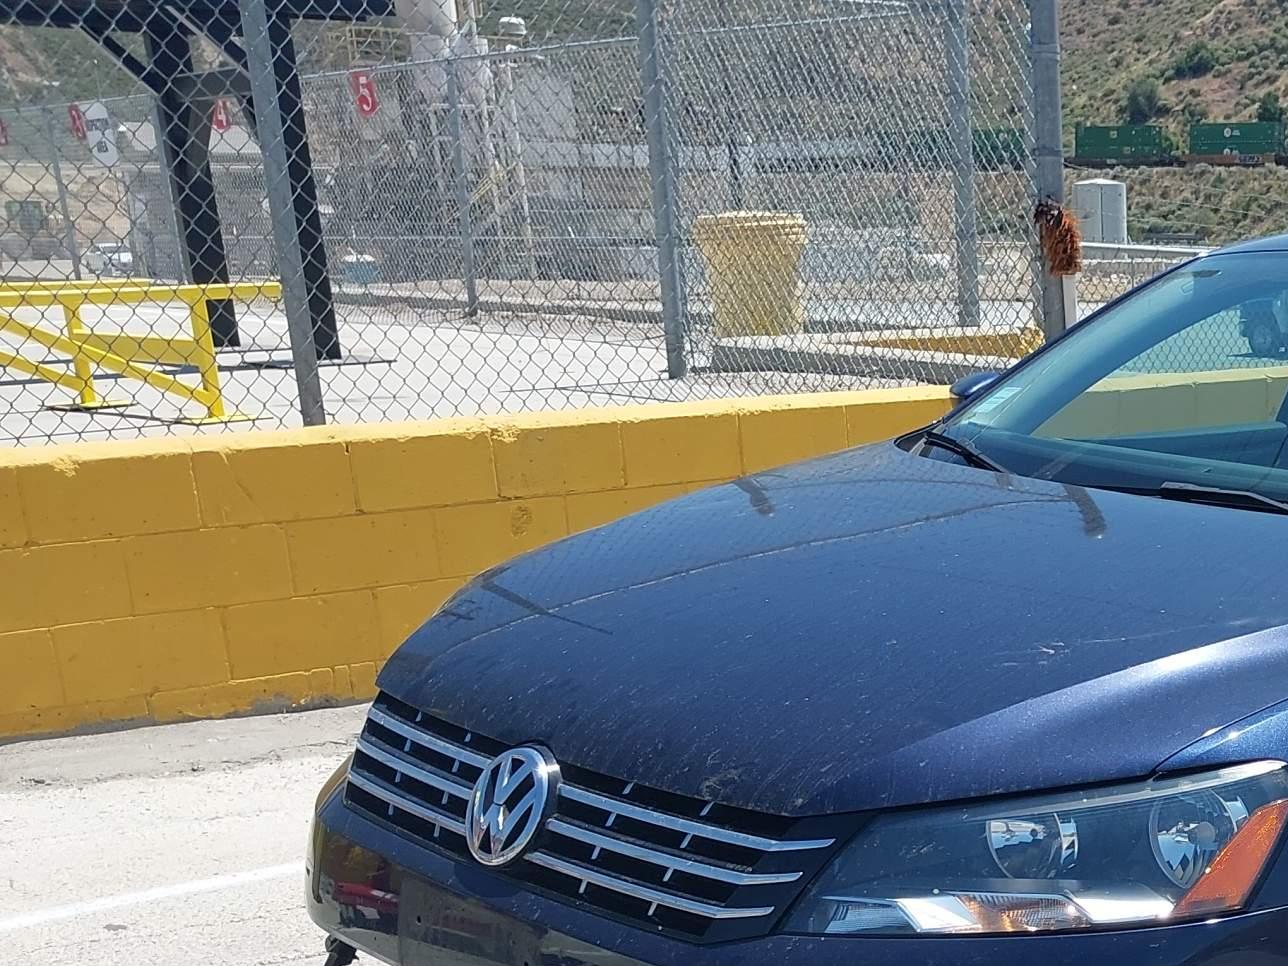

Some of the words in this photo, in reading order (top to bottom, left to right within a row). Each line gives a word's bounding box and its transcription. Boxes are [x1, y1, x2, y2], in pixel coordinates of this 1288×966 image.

[356, 76, 372, 111] 5
[217, 100, 227, 127] 4
[465, 747, 549, 866] VW
